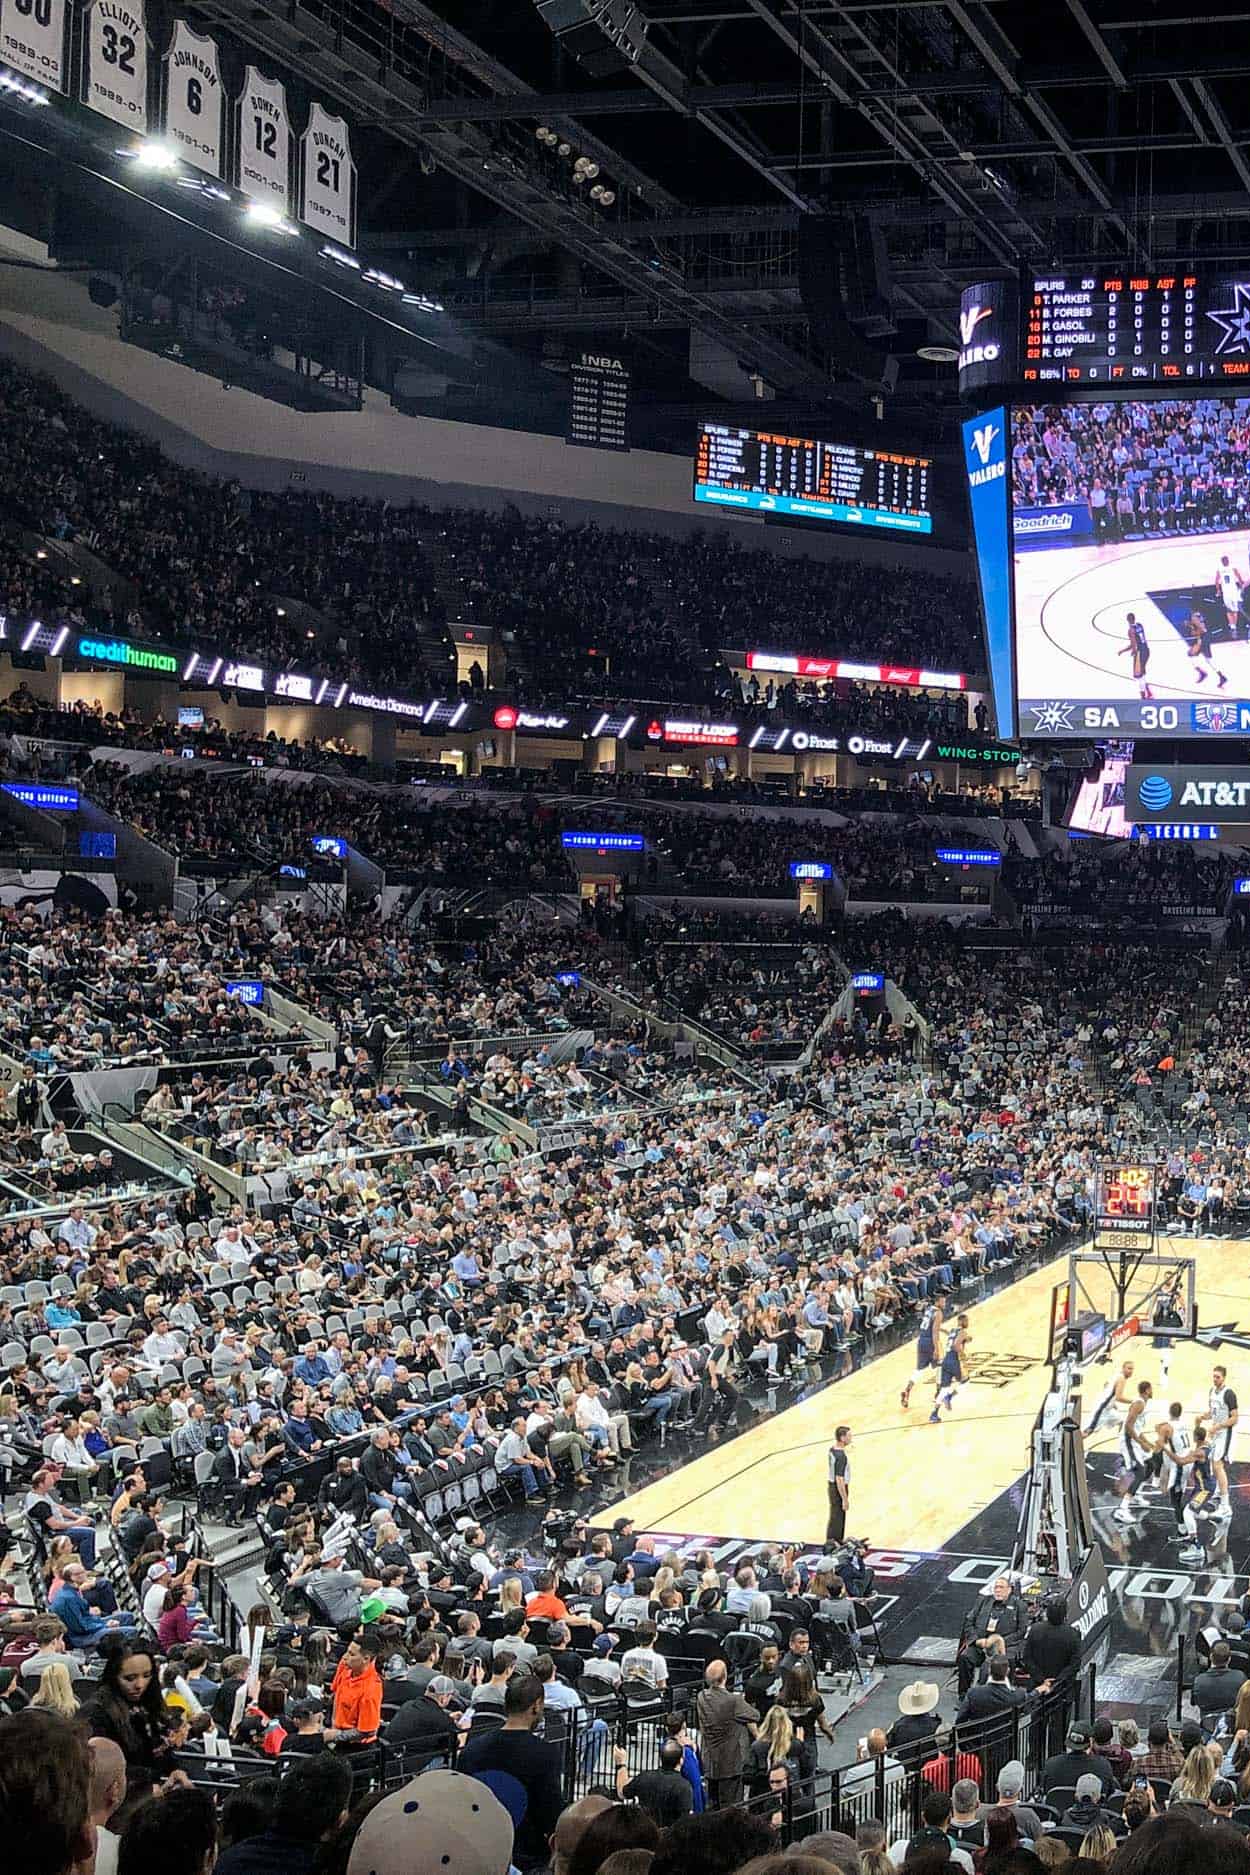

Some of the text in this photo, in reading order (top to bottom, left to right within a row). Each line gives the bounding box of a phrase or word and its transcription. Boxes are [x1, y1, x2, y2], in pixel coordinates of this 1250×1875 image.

[99, 2, 141, 36] ELLIOTT
[102, 24, 135, 76] 32
[174, 51, 217, 86] JOHNSON
[187, 77, 202, 115] 6
[250, 96, 280, 122] BOWEN
[254, 116, 277, 159] 12
[313, 132, 345, 160] DUNCAN
[317, 151, 339, 192] 21
[1034, 281, 1064, 291] SPURS
[1104, 281, 1122, 290] PTS
[1157, 280, 1175, 288] AST
[1184, 278, 1196, 288] PF
[1052, 294, 1090, 304] PARKER
[1029, 310, 1040, 318] 11
[1053, 307, 1092, 317] FORBES
[1052, 321, 1085, 330] GASOL
[1055, 334, 1095, 343] GINOBILI
[1053, 347, 1073, 357] GAY
[589, 355, 622, 370] NBA
[1067, 369, 1080, 378] TO
[1089, 368, 1097, 377] 0
[1112, 367, 1124, 376] FT
[1132, 367, 1148, 376] 0%
[1162, 366, 1180, 376] TOL
[1208, 364, 1214, 374] 1
[1222, 363, 1249, 374] TEAM
[968, 461, 1004, 487] VALERO
[1014, 513, 1072, 530] Goodrich
[80, 641, 176, 673] credithuman
[387, 698, 423, 717] Diamond
[1084, 707, 1120, 728] SA
[1140, 705, 1178, 729] 30
[665, 721, 737, 736] WEST LOOP
[808, 736, 839, 749] Frost
[864, 740, 893, 753] Frost
[38, 793, 69, 804] LOTTERY
[1179, 781, 1250, 806] AT&T
[1155, 826, 1201, 839] TEXAS
[600, 837, 632, 846] LOTTERY
[1108, 1186, 1142, 1214] 24
[1113, 1220, 1149, 1228] TISSOT
[1180, 1433, 1190, 1448] 11
